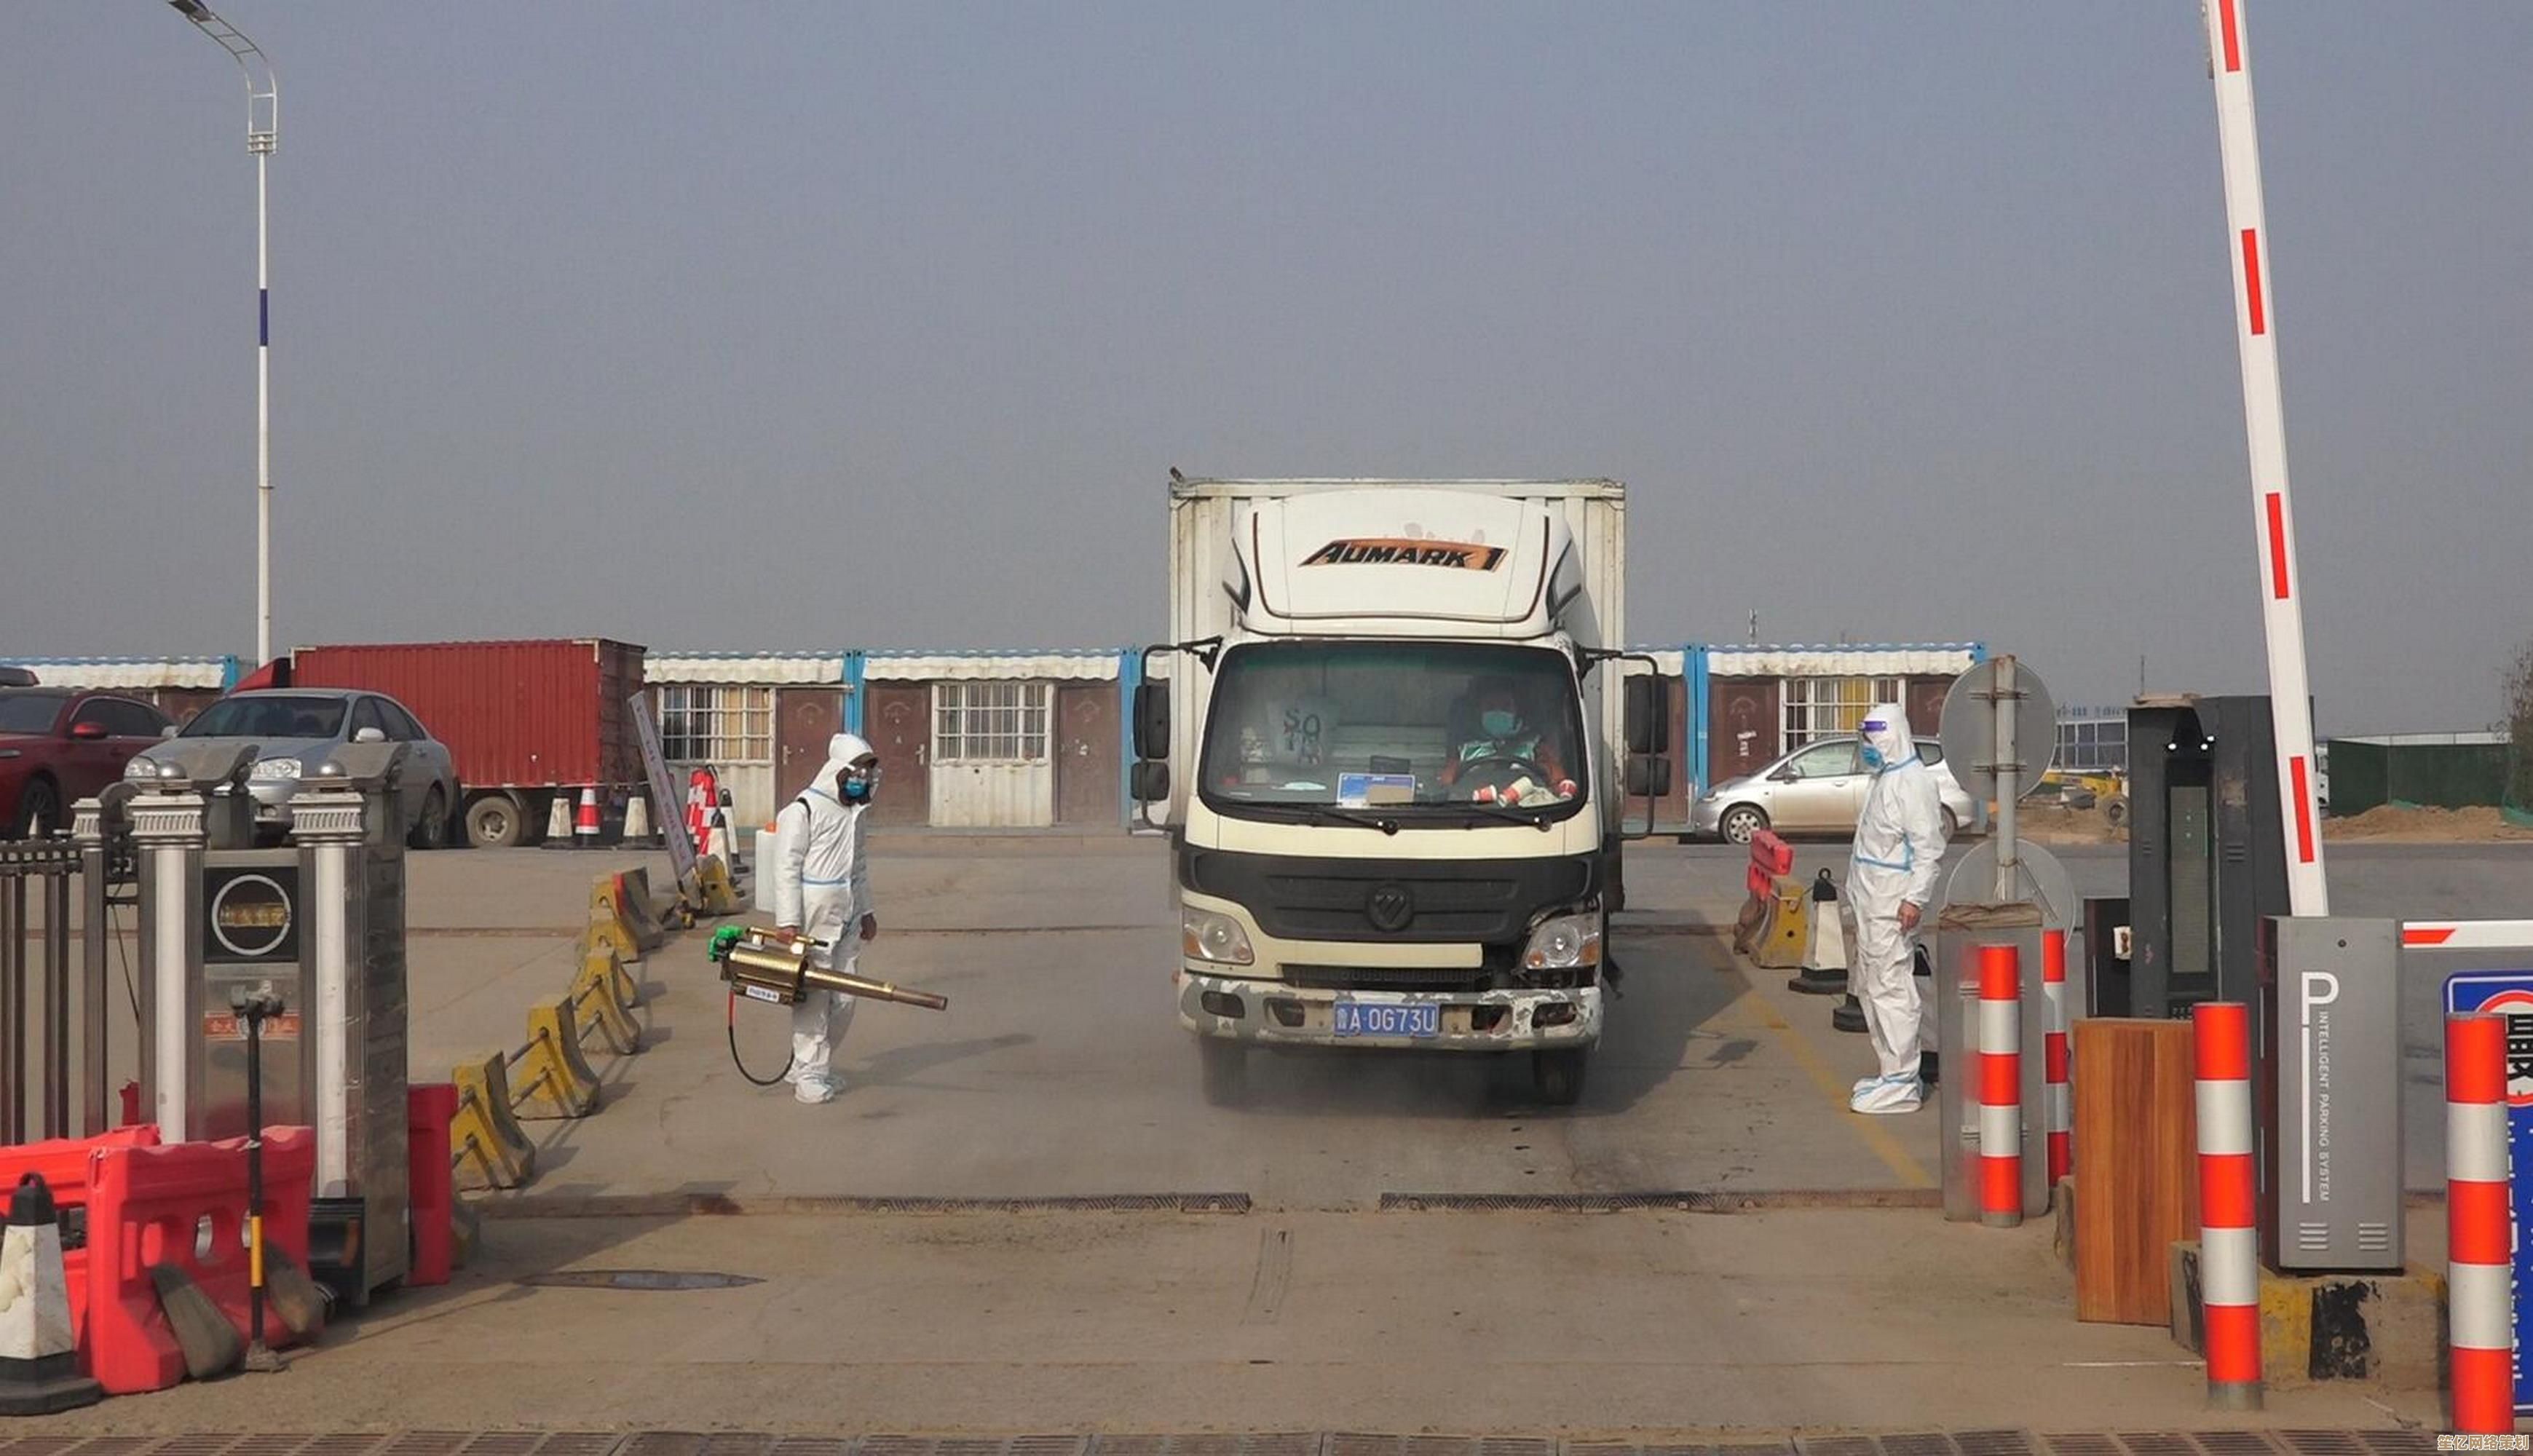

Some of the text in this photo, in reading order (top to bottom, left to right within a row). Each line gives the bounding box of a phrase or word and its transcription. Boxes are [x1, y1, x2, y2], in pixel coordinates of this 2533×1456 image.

[1298, 540, 1471, 567] AUMARK
[2318, 1010, 2331, 1201] INTELLIGENT PARKING SYSTEM
